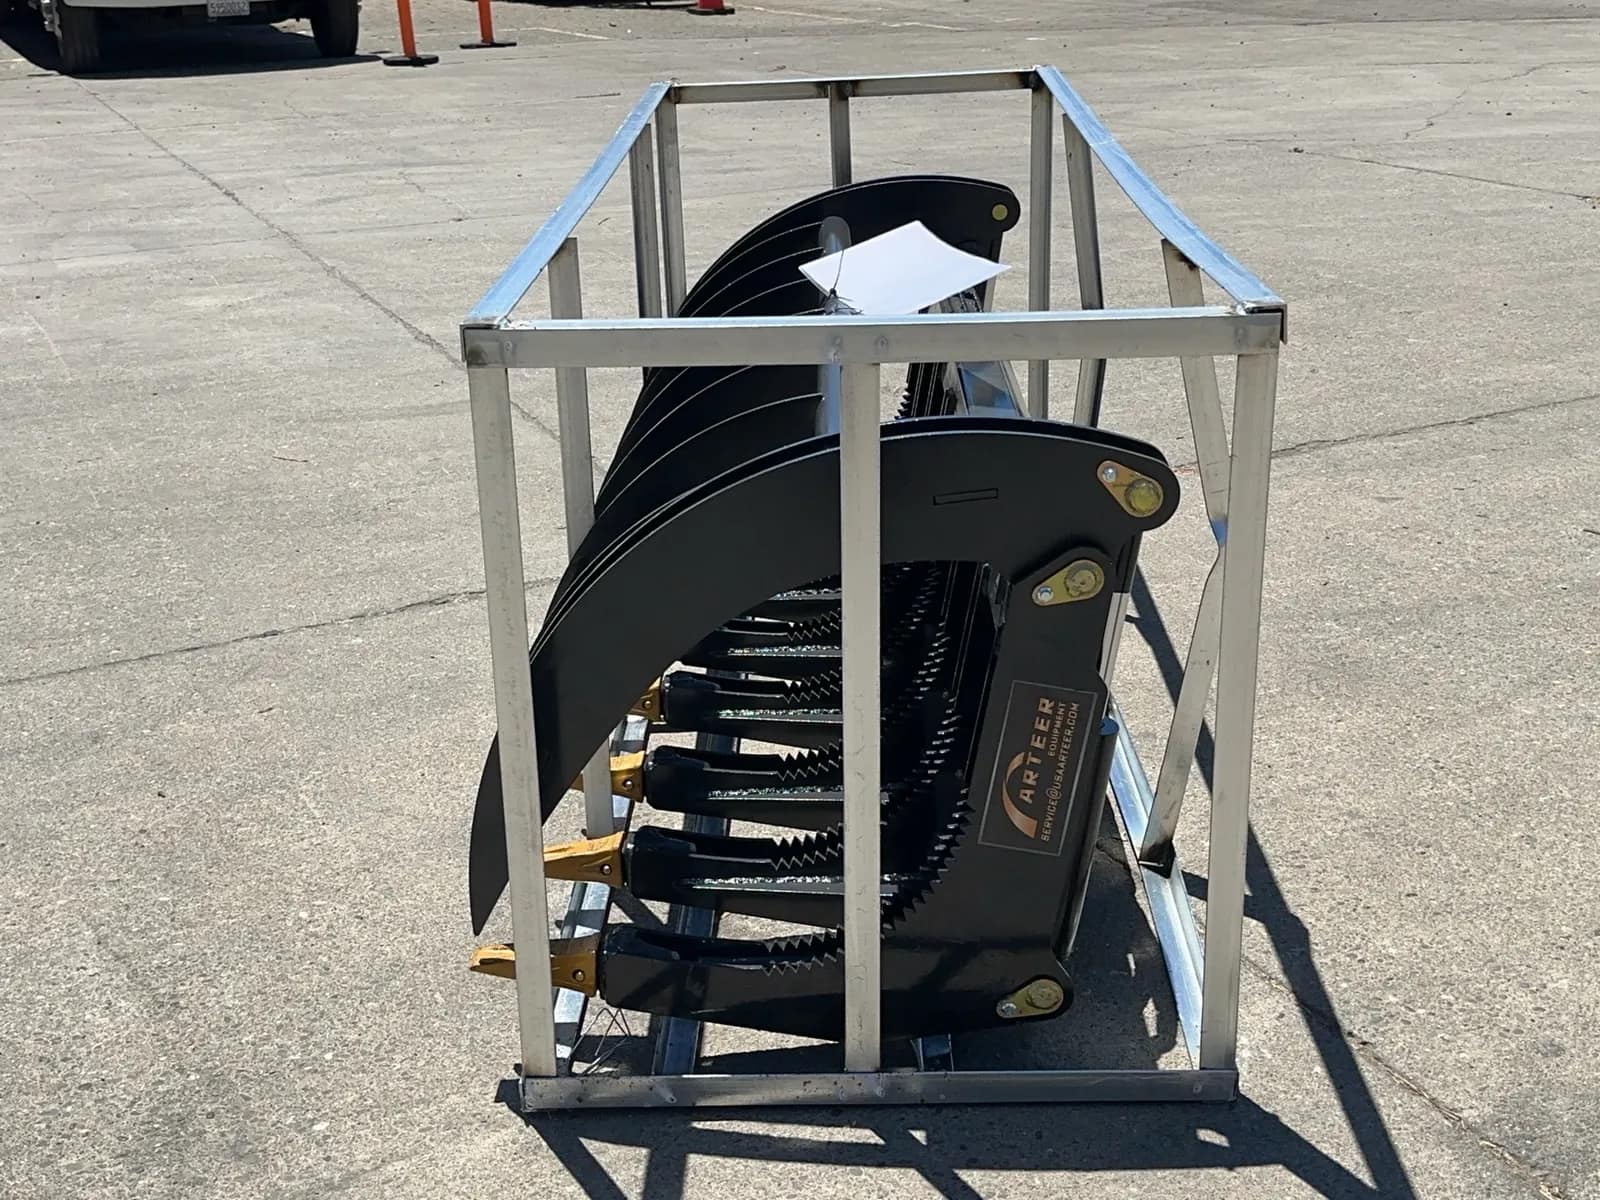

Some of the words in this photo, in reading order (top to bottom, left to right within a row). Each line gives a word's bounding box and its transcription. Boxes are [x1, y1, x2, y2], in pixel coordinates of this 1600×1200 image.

[1018, 697, 1055, 804] ARTEER
[1040, 702, 1080, 842] SERVICE@USAARTEER.COM
[1047, 702, 1066, 757] EQUIPMENT
